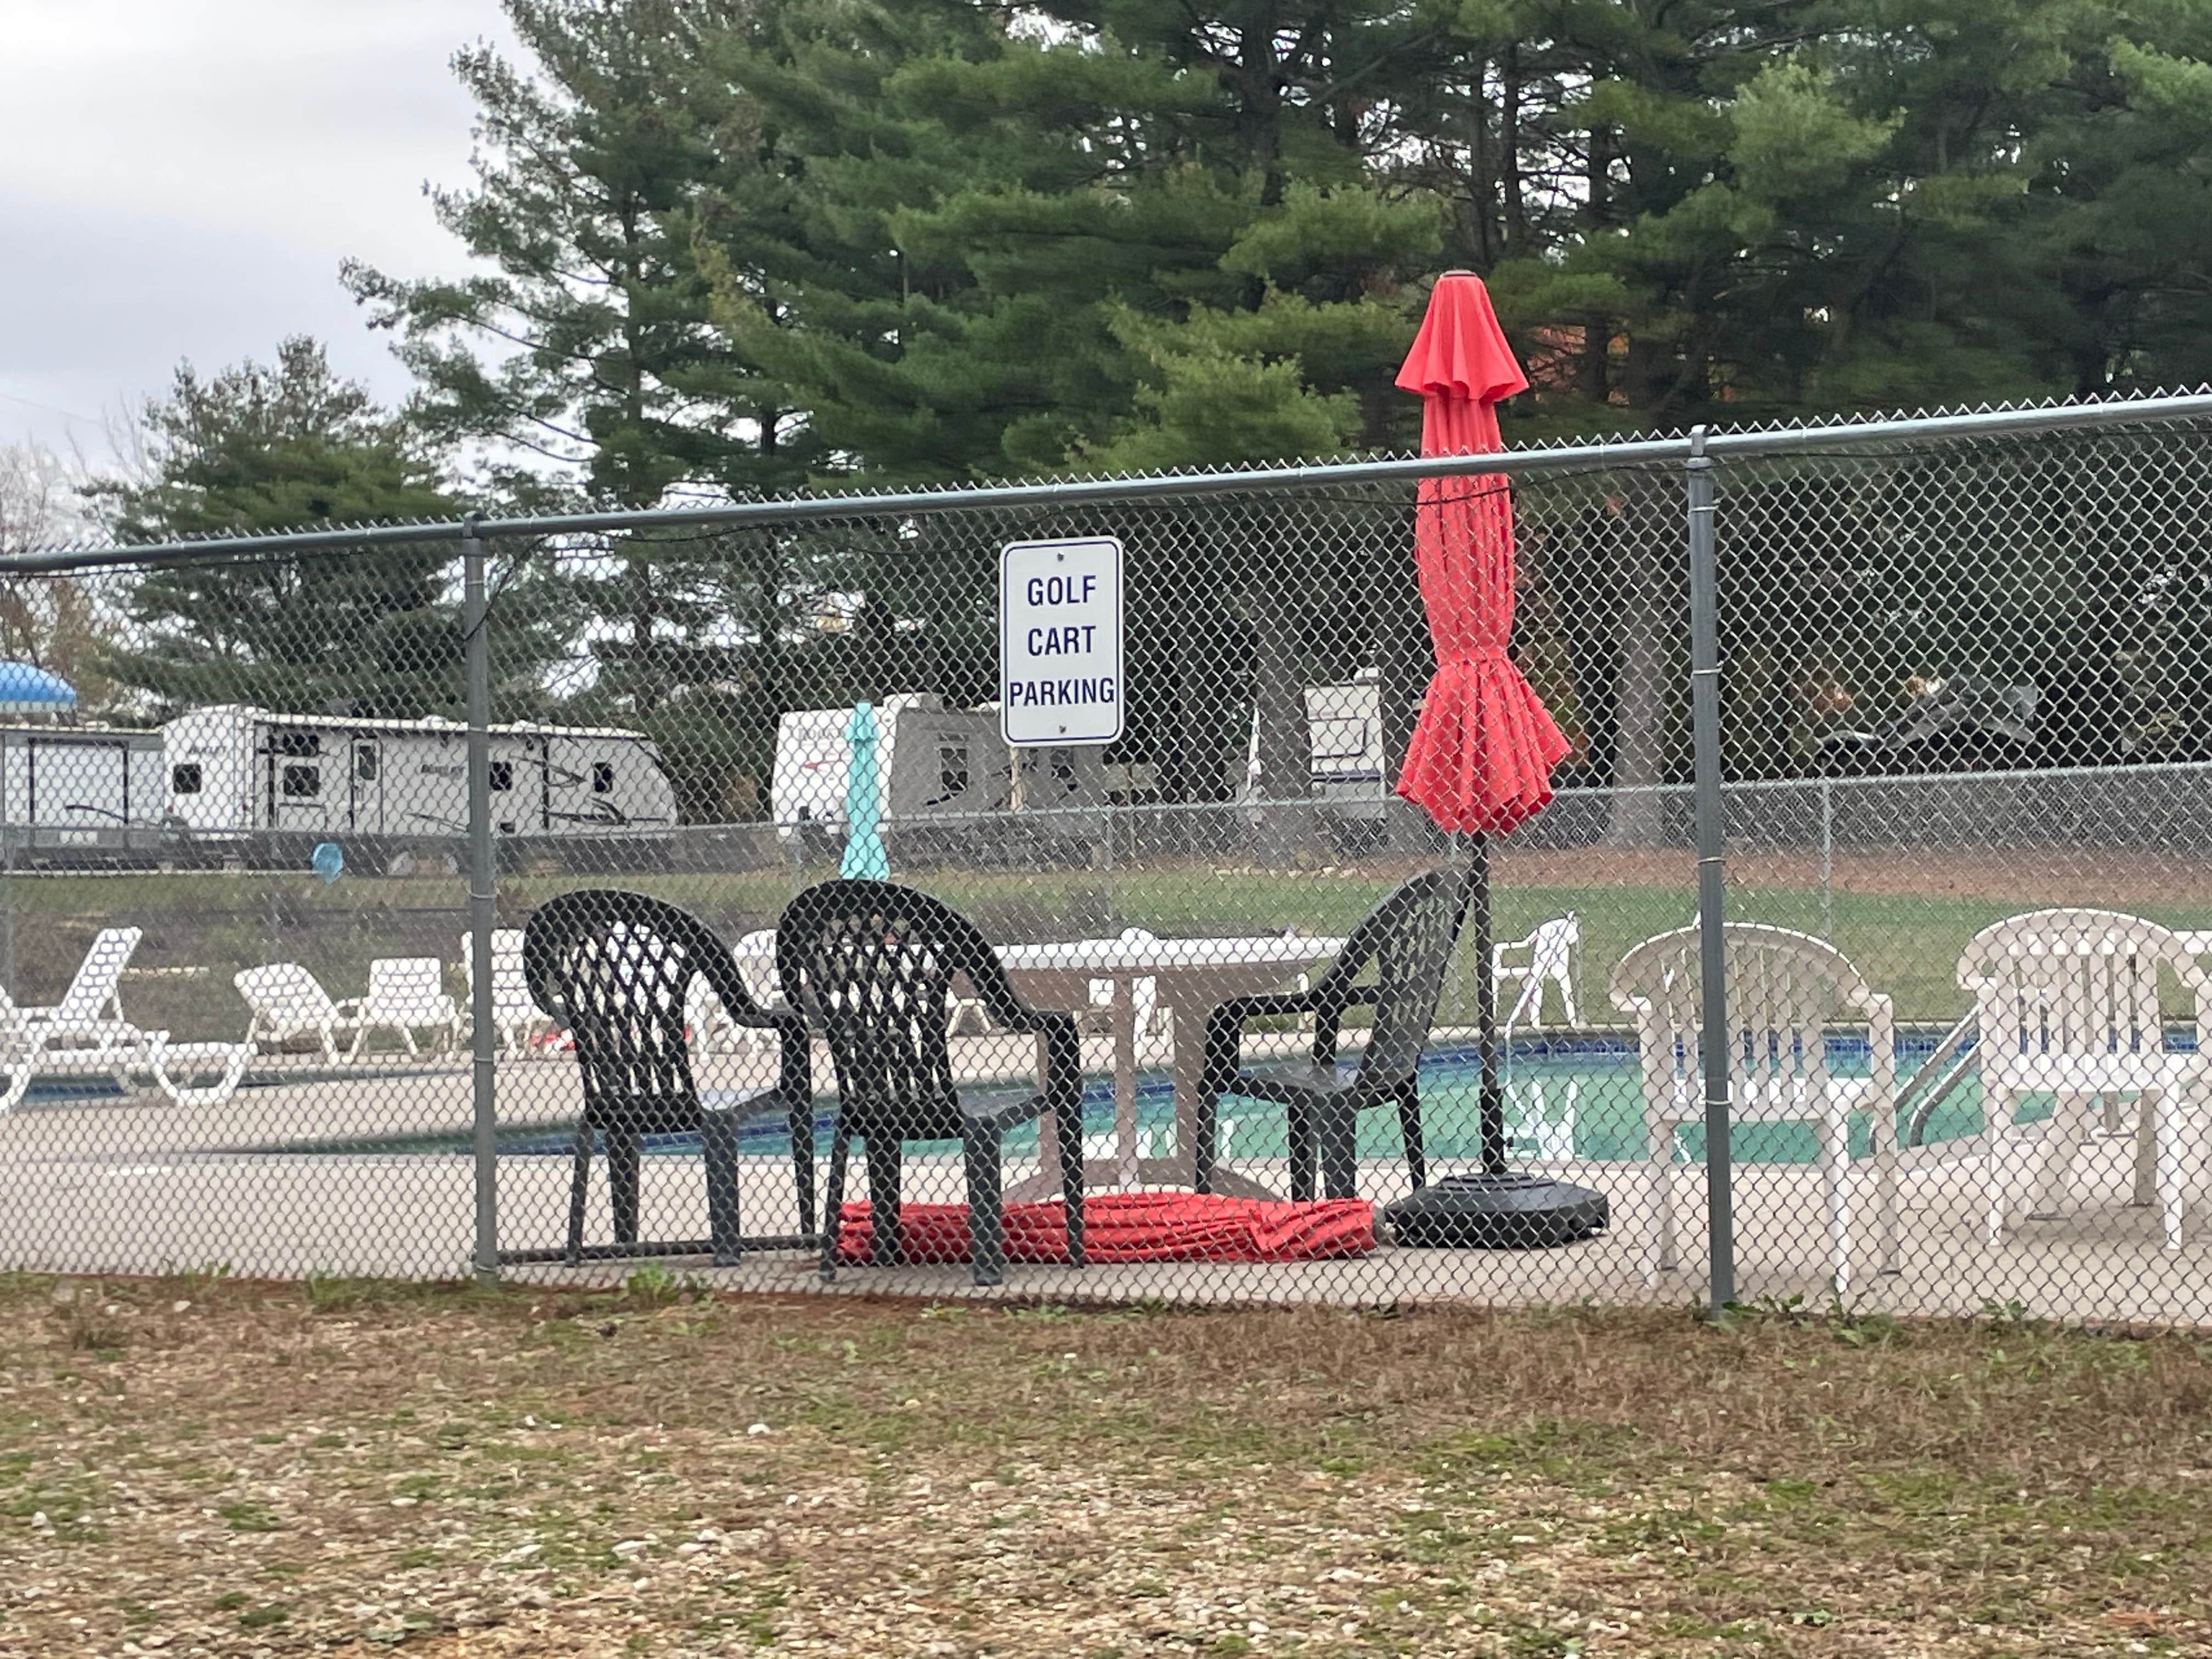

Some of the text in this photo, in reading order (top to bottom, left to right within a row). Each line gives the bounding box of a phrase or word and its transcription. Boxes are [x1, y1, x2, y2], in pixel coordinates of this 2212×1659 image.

[1028, 575, 1096, 606] GOLF
[1028, 625, 1096, 656] CART
[1009, 677, 1114, 707] PARKING
